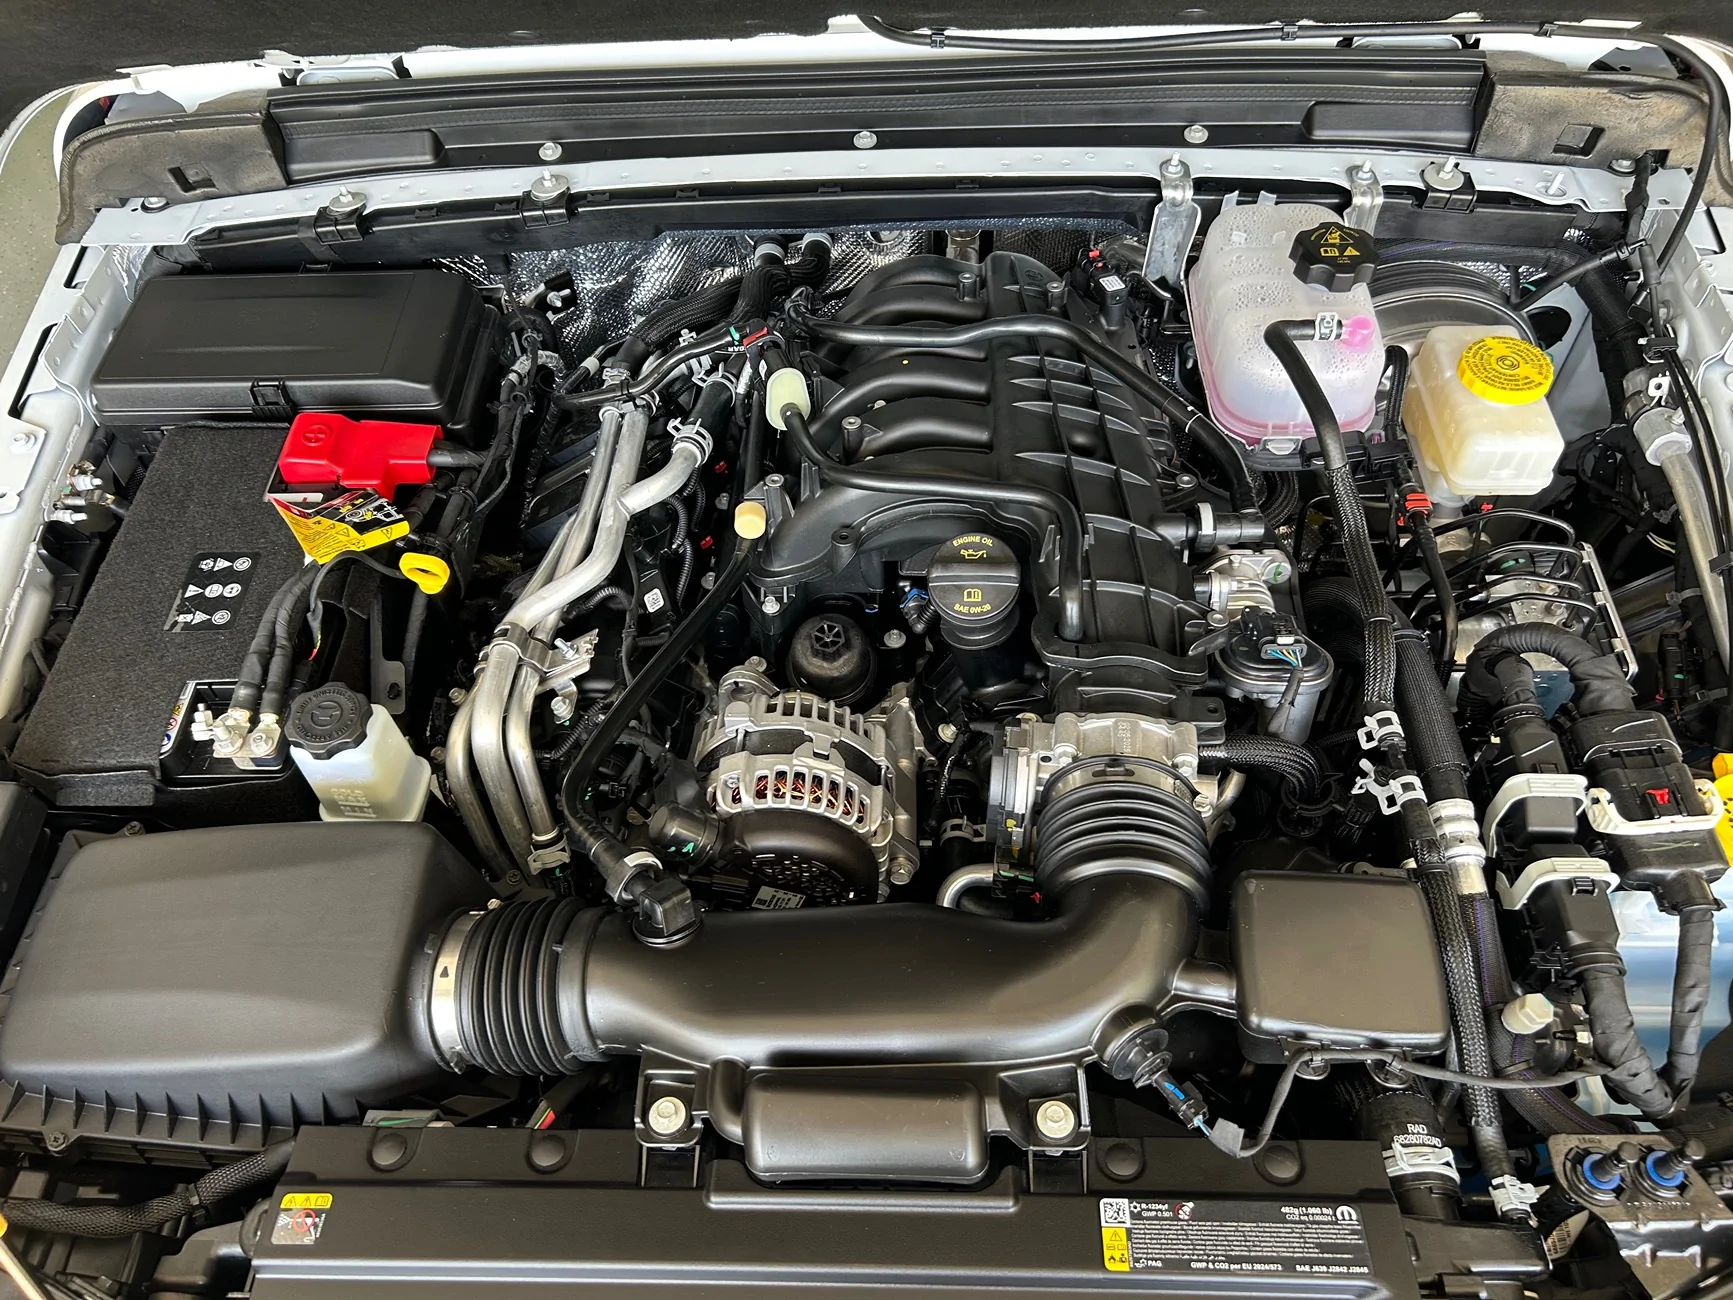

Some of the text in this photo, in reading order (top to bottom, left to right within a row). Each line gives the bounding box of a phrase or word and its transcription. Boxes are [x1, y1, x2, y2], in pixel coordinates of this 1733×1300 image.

[952, 535, 994, 547] ENGINE OIL
[953, 603, 992, 614] SAE 0W-20
[330, 787, 364, 797] COLD
[1406, 1123, 1428, 1134] RAD
[1147, 1260, 1162, 1268] PAG
[1190, 1261, 1207, 1269] GWP
[1214, 1262, 1229, 1270] CO2
[1295, 1264, 1311, 1272] SAE
